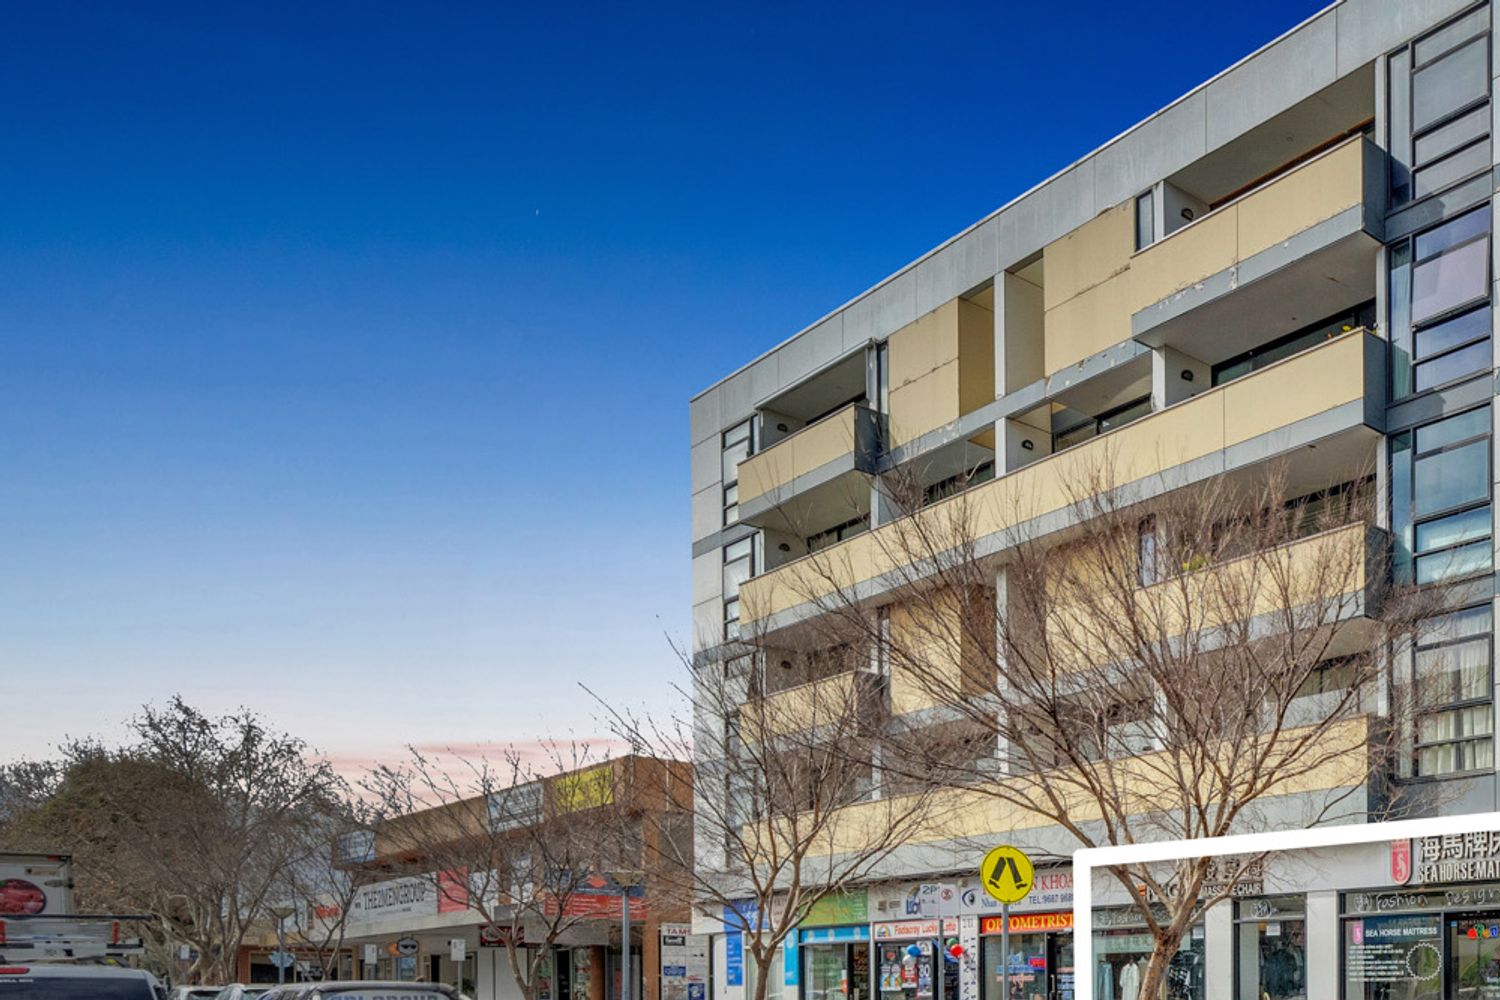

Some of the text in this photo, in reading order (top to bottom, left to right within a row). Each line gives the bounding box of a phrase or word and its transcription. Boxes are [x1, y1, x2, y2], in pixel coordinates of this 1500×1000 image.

[1417, 864, 1439, 883] SEA
[1439, 861, 1475, 881] HORSE
[985, 912, 1073, 932] OPOMETRIST
[1365, 926, 1438, 938] SEA HORSE MATTRESS
